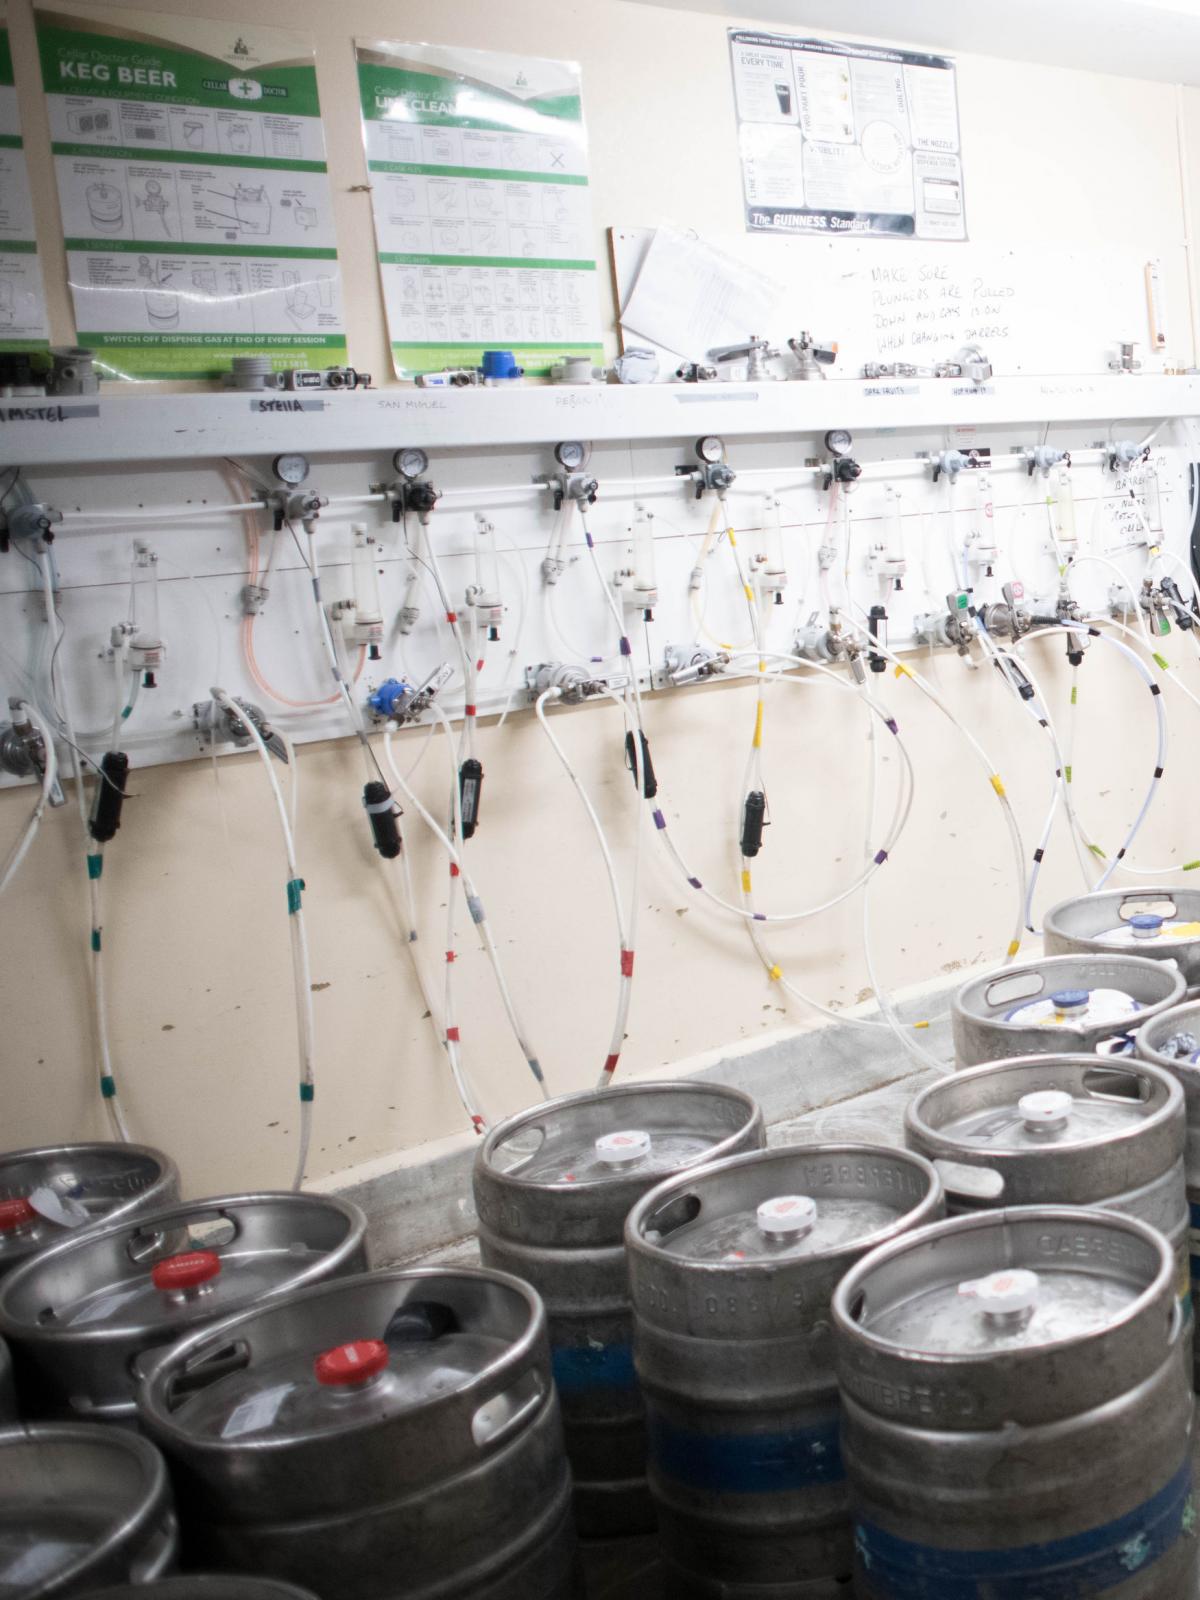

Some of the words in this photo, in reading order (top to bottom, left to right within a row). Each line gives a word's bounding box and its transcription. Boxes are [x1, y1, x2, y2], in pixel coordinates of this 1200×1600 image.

[741, 57, 764, 66] EVERY
[766, 59, 784, 70] TIME
[59, 60, 111, 82] KEG
[118, 66, 177, 89] BEER
[753, 212, 771, 225] The
[773, 212, 828, 229] GUINNESS
[831, 216, 872, 232] Standard
[871, 265, 908, 283] MAKE
[919, 263, 949, 282] SURE
[871, 287, 929, 307] PLUNGERS
[940, 283, 963, 299] ARE
[972, 277, 1016, 299] PULLED
[873, 312, 906, 329] DOWN
[916, 311, 936, 323] AND
[103, 335, 141, 344] SWITCH
[142, 335, 160, 344] OFF
[162, 335, 203, 344] DISPENSE
[204, 335, 222, 344] GAS
[223, 335, 233, 344] AT
[235, 335, 249, 344] END
[250, 335, 265, 344] OF
[267, 336, 291, 345] EVERY
[293, 336, 326, 345] SESSION
